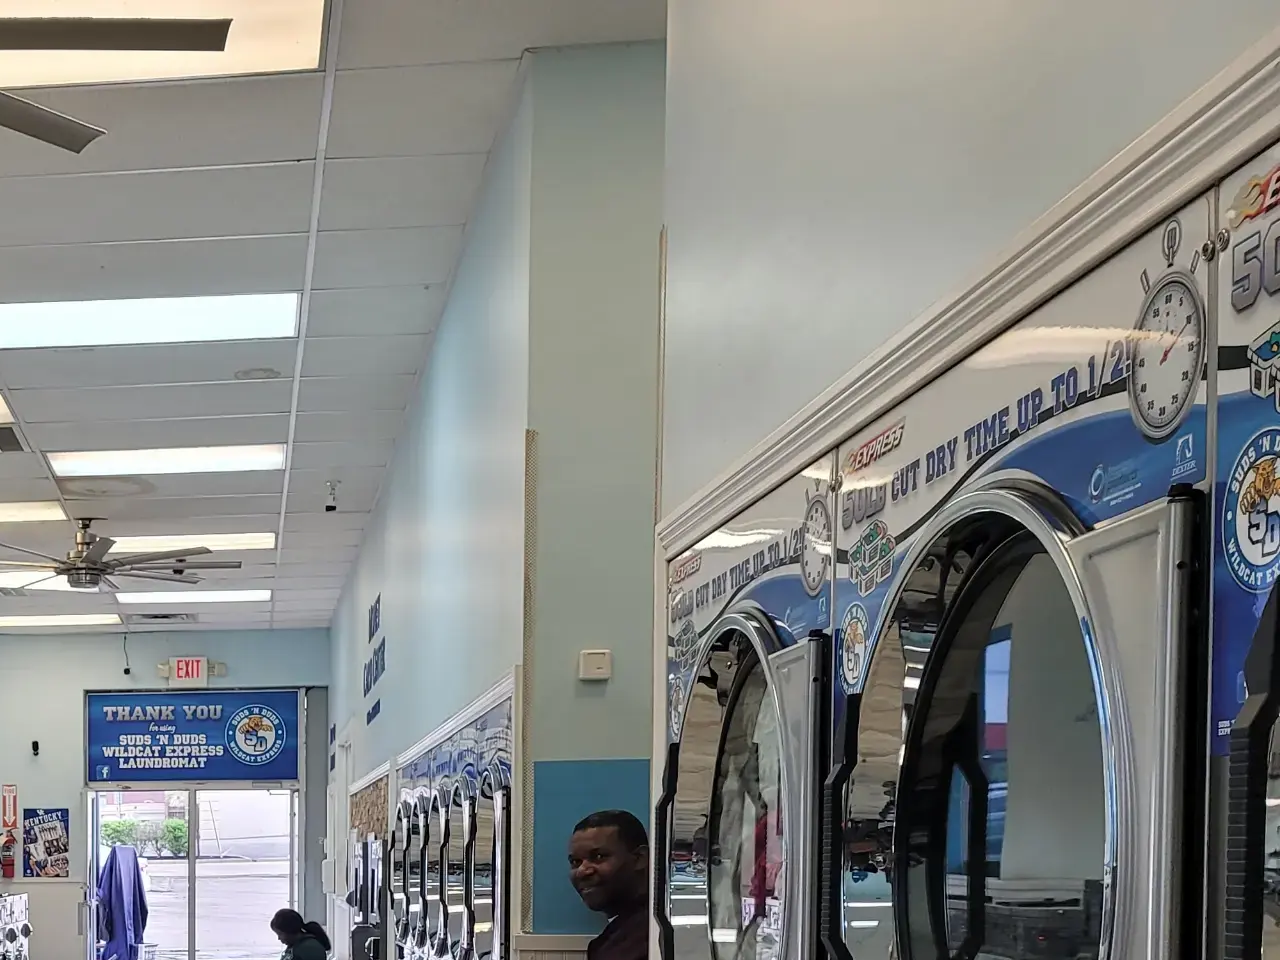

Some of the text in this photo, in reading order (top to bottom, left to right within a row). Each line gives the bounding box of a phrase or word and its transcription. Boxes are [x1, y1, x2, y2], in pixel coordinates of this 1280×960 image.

[842, 480, 886, 531] 50LB
[891, 459, 920, 502] CUT
[924, 436, 958, 486] DRY
[964, 406, 1010, 461] TIME
[1017, 387, 1043, 434] UP
[1051, 365, 1079, 415] TO
[856, 422, 904, 470] EXPRESS
[1172, 460, 1196, 476] DEXTER
[1231, 446, 1256, 494] SUDS
[1227, 538, 1262, 586] WILDCAT
[696, 582, 710, 608] CUT
[712, 571, 727, 600] DRY
[729, 558, 750, 589] TIME
[753, 549, 765, 578] UP
[769, 539, 781, 568] TO
[176, 660, 201, 679] EXIT
[103, 705, 223, 721] THANK YOU
[231, 709, 249, 726] SUDS
[261, 708, 280, 725] DUDS
[149, 722, 176, 734] for using
[119, 734, 206, 745] SUDS 'N DUDS
[102, 746, 224, 757] WILDCAT EXPRESS
[230, 740, 282, 762] WILDCAT EXPRESS
[119, 758, 207, 769] LAUNDROMAT
[24, 811, 62, 827] KENTUCKY
